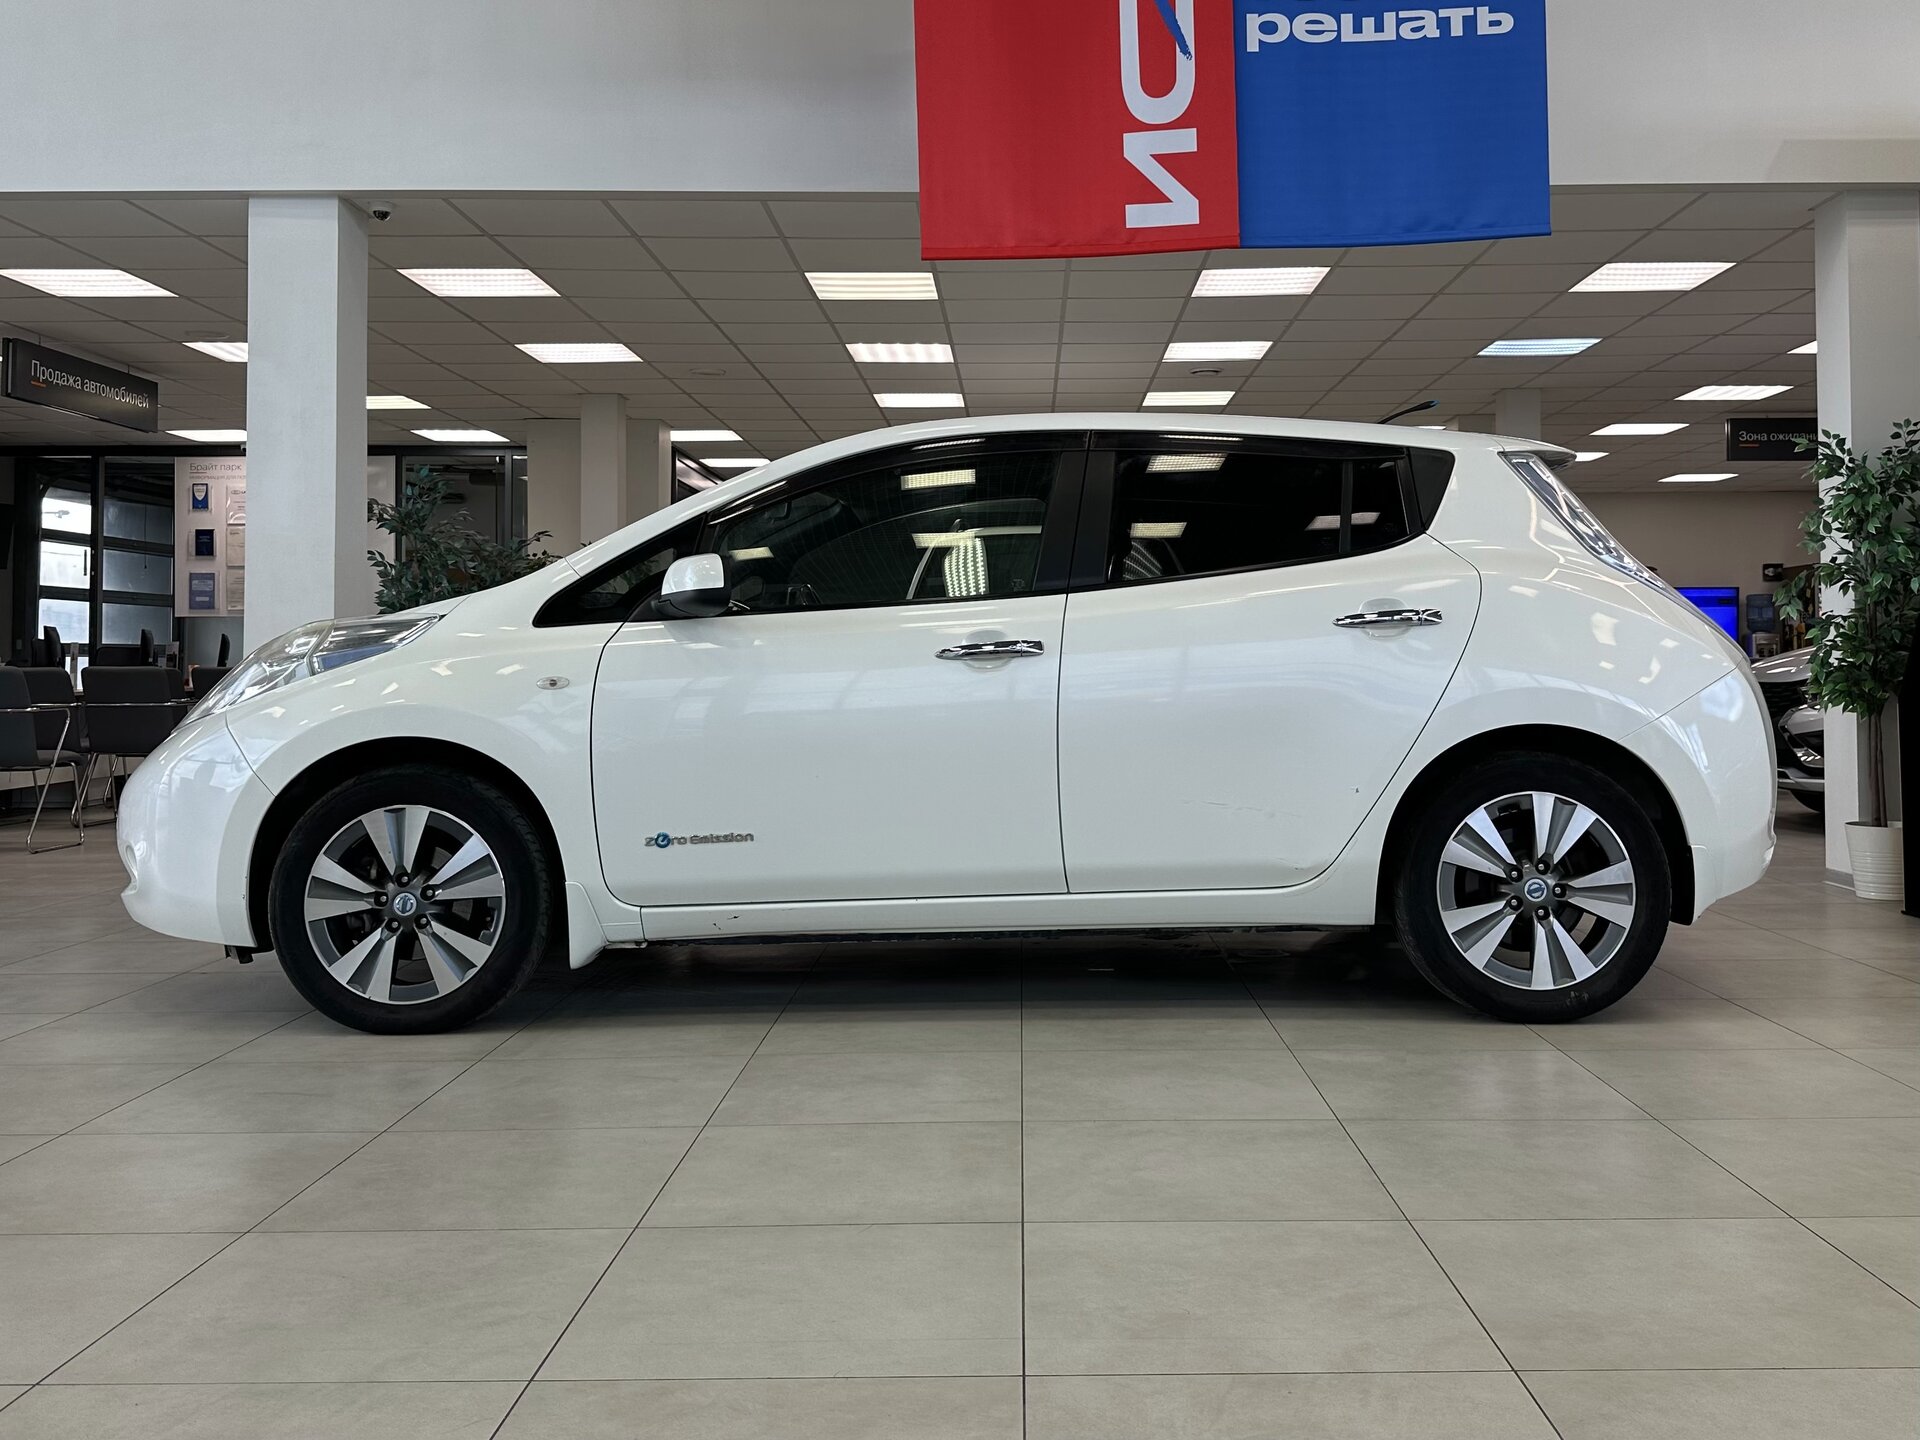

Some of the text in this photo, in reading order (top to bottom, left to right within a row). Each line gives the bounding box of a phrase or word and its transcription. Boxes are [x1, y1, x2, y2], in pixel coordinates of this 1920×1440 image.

[1246, 6, 1514, 52] решать
[31, 359, 149, 408] Продажа автомобилей
[1738, 430, 1768, 441] Зона
[189, 462, 242, 472] Брайт парк
